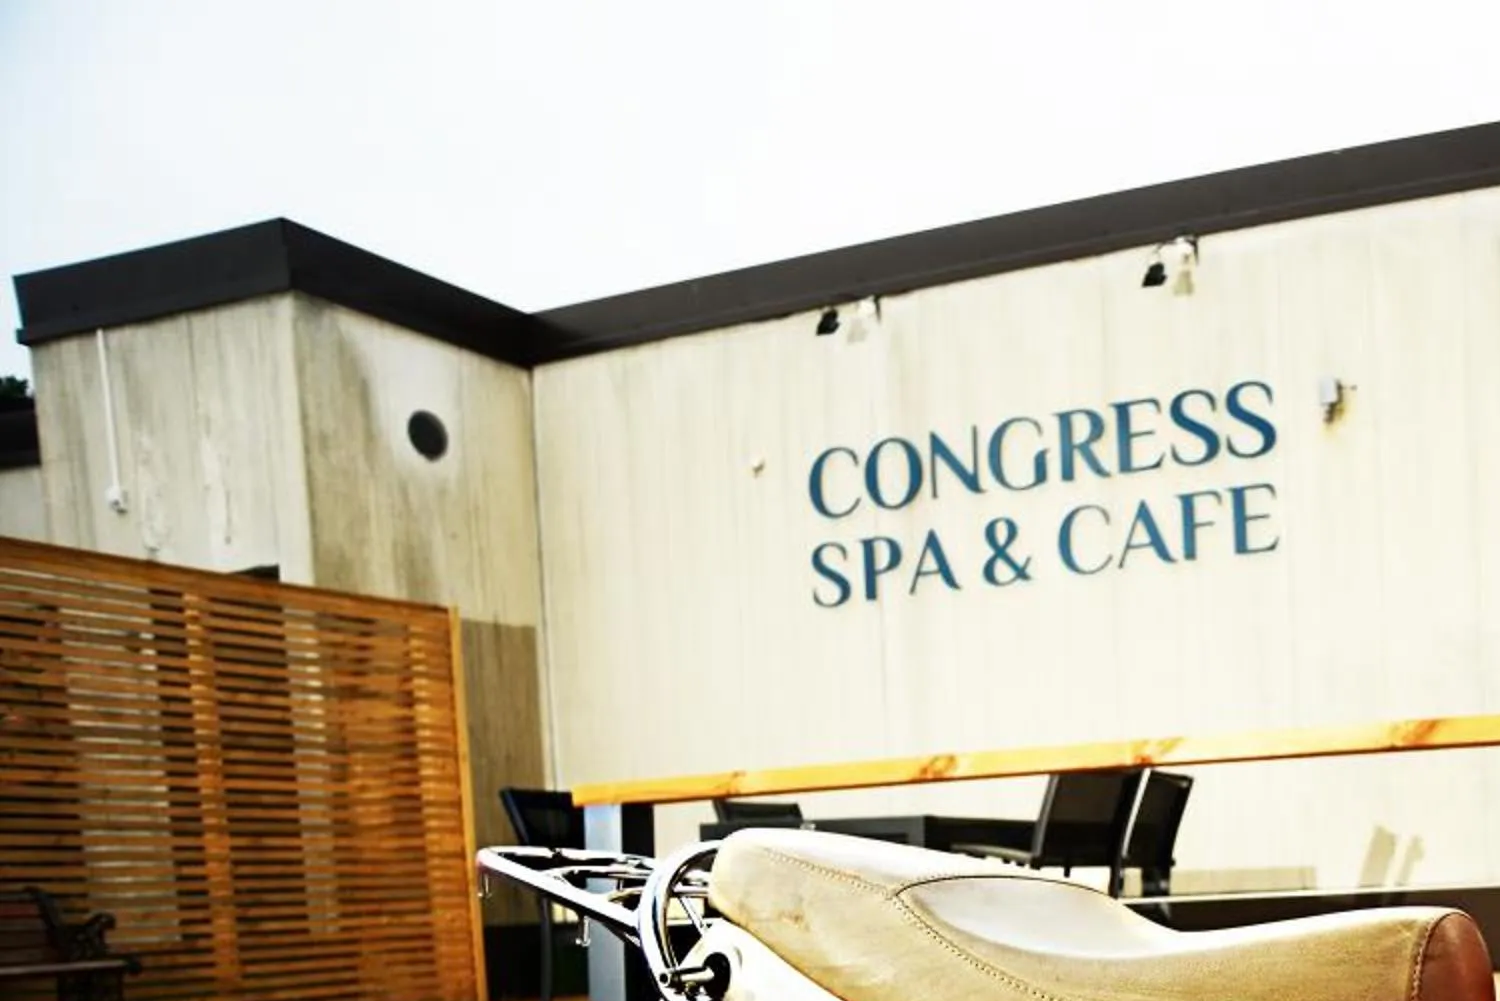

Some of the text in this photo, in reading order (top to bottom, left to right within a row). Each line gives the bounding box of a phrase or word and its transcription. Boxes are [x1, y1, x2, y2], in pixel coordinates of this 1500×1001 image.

[808, 380, 1277, 519] CONGRESS
[811, 482, 1279, 608] SPA & CAFE
